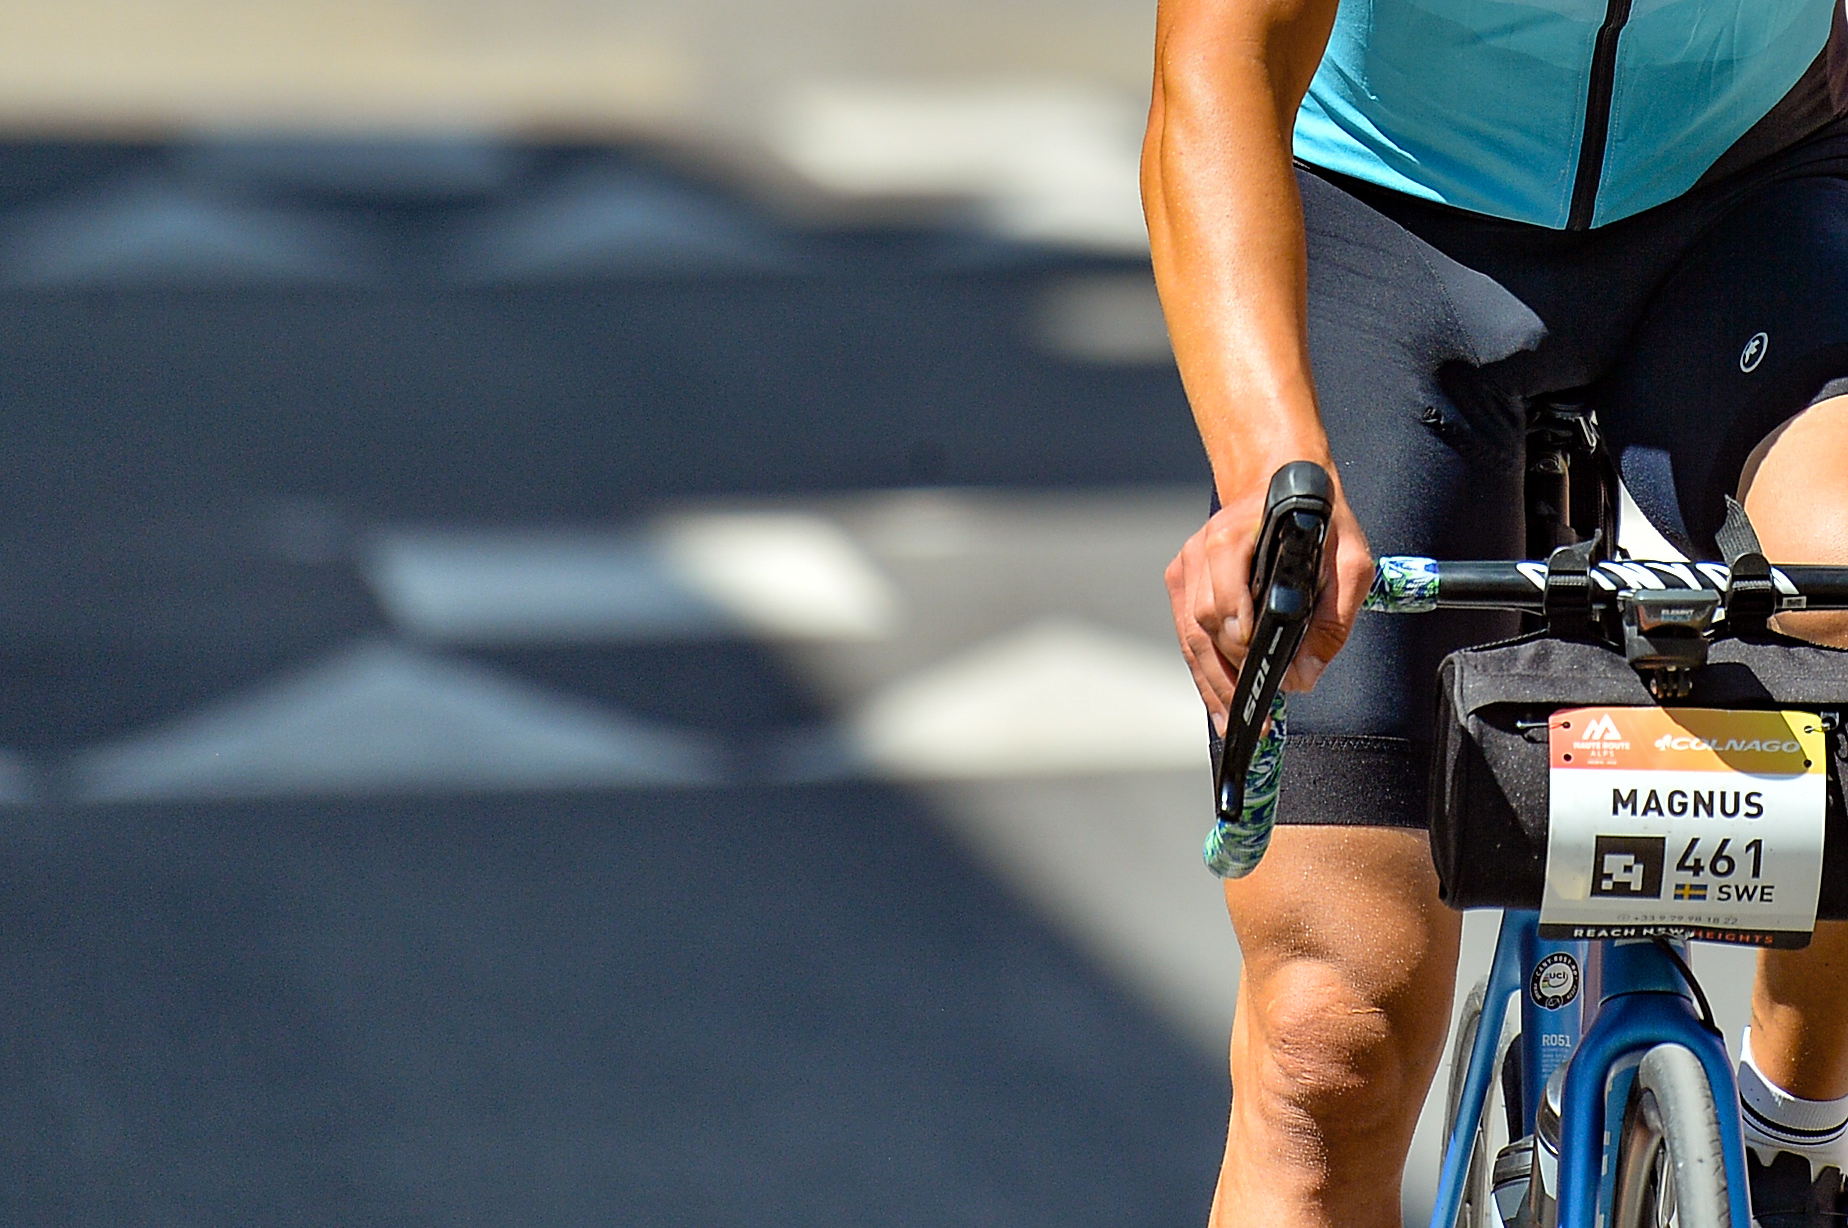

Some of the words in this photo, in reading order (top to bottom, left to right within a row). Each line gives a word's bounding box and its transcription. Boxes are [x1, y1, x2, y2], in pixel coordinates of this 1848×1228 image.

[1242, 658, 1270, 727] 105
[1671, 737, 1800, 753] COLNAGO
[1612, 788, 1764, 819] MAGNUS
[1676, 837, 1763, 879] 461
[1717, 884, 1774, 902] SWE
[1573, 928, 1635, 938] REACH
[1694, 930, 1774, 944] HEIGHTS
